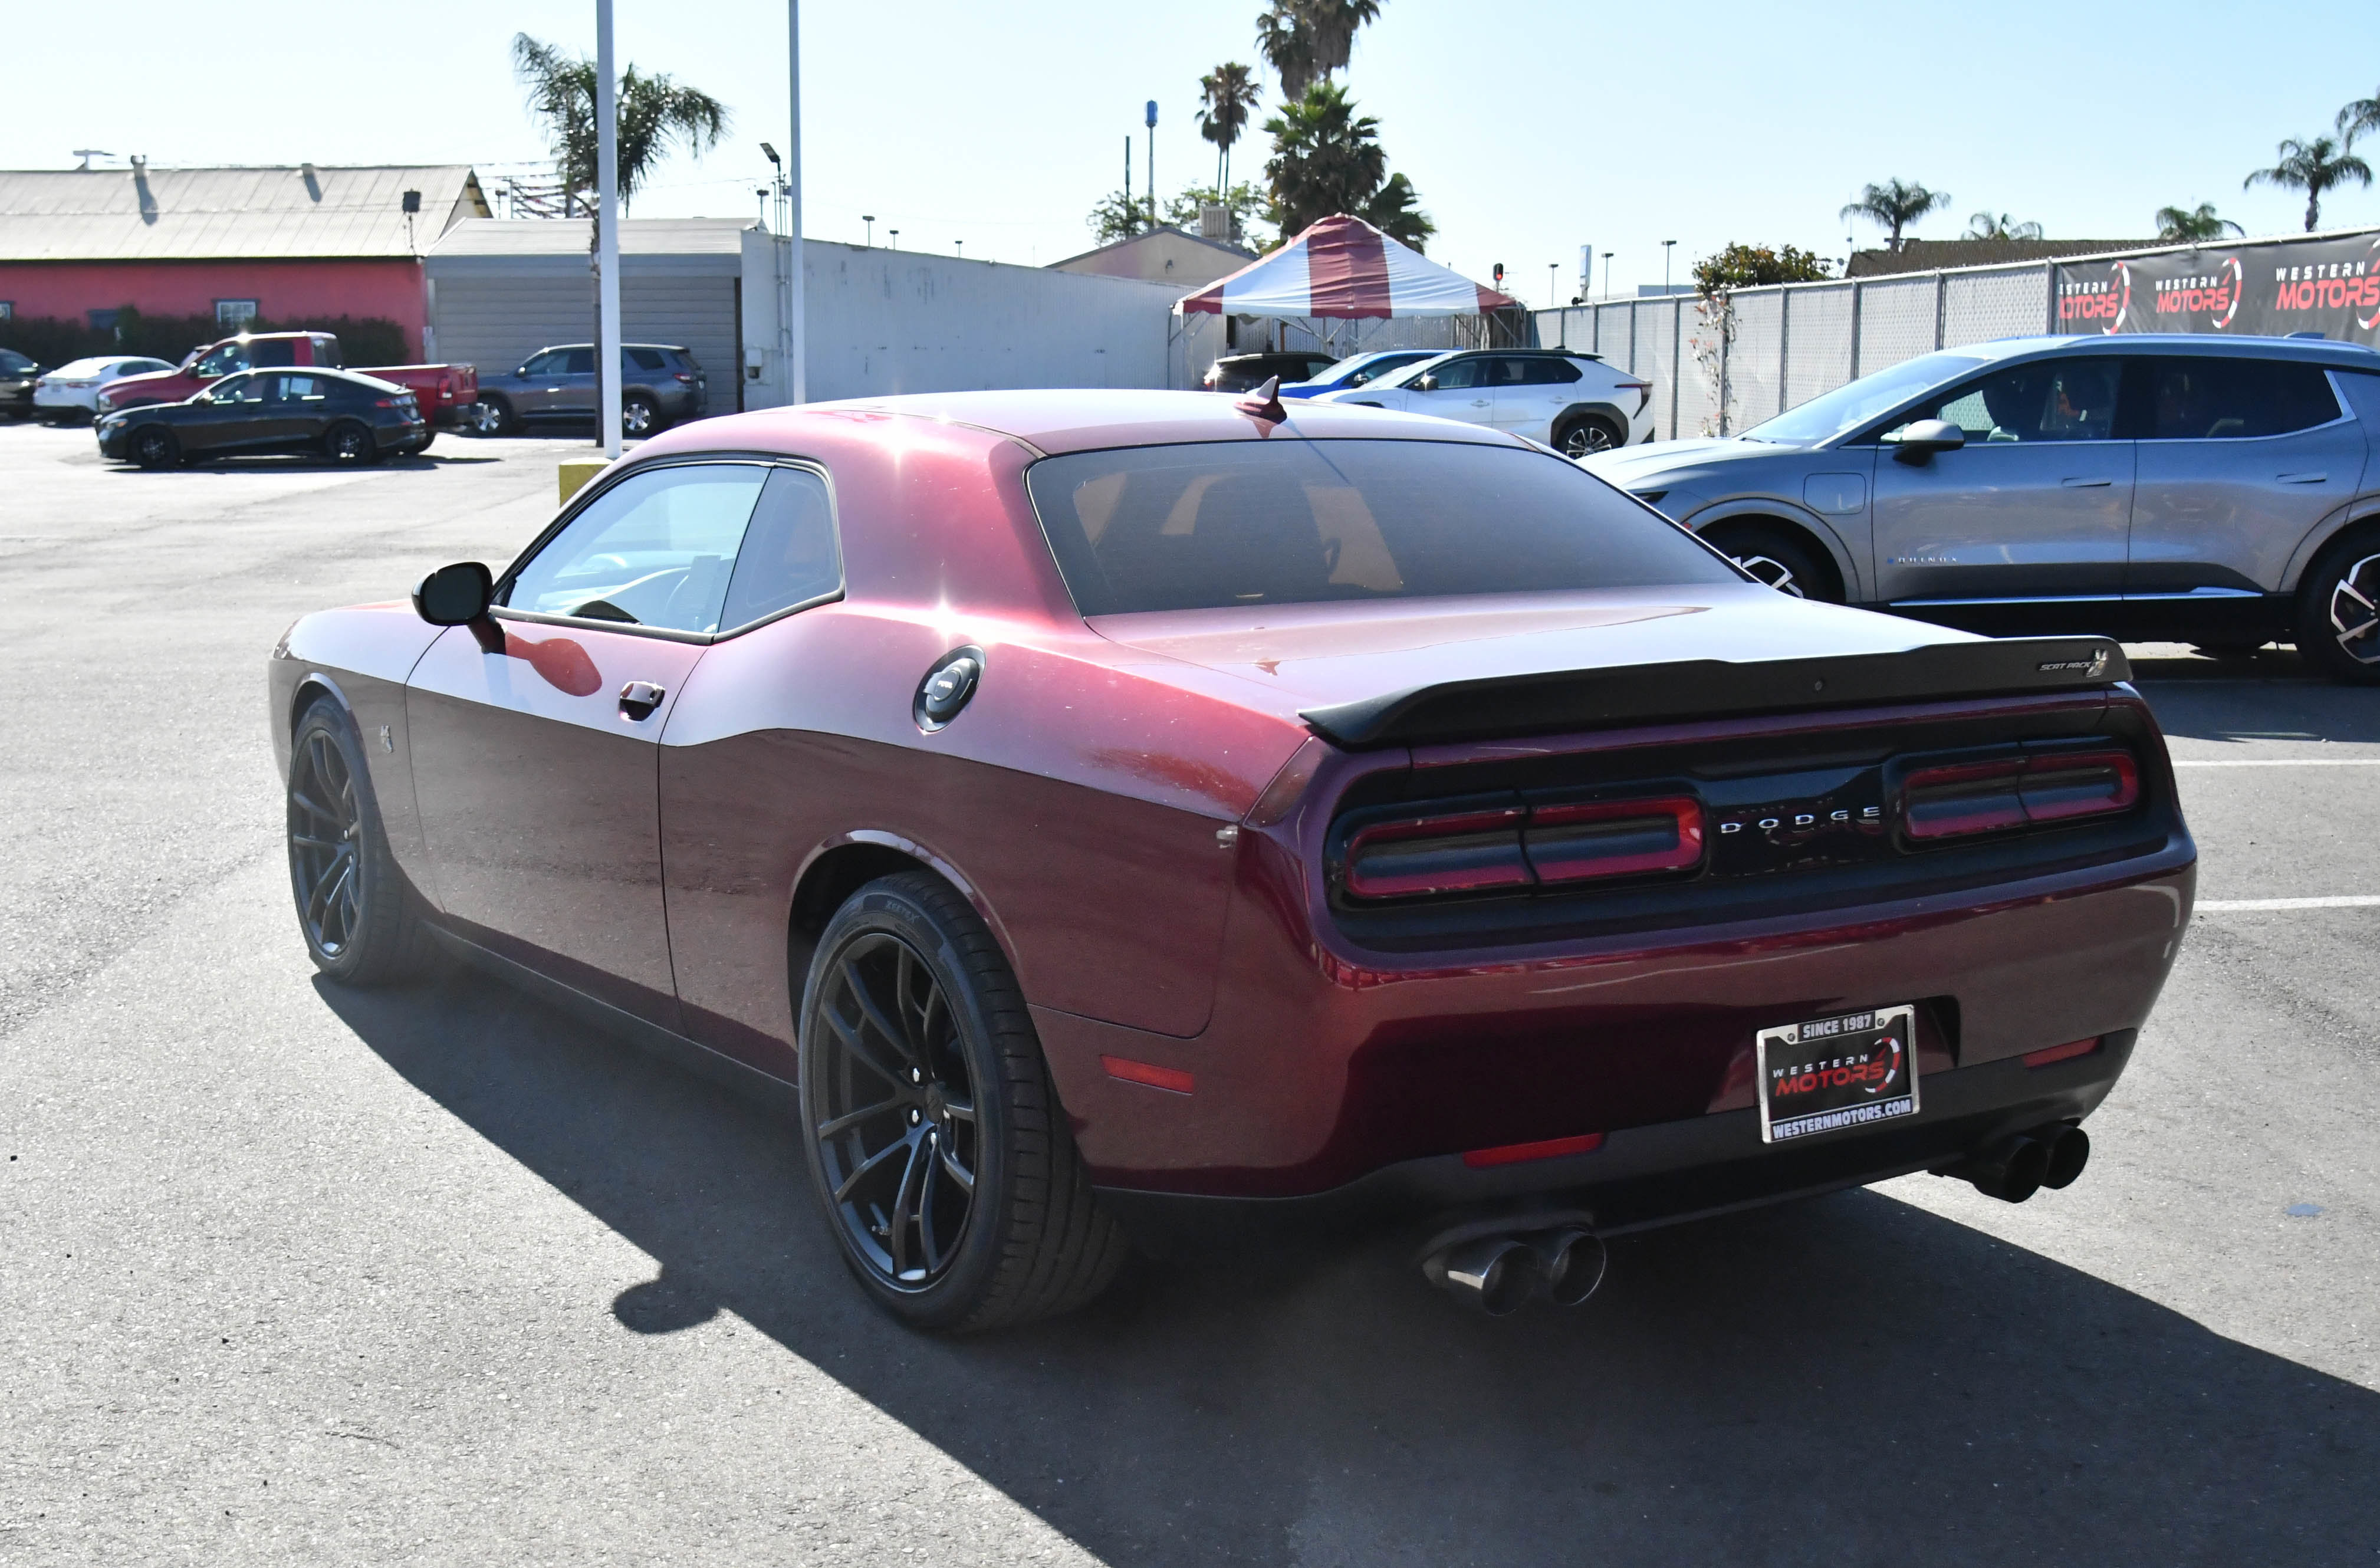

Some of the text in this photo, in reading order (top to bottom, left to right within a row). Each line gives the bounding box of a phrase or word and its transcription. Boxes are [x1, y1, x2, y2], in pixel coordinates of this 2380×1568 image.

[2276, 261, 2365, 281] WESTERN
[2155, 276, 2217, 291] WESTERN
[2276, 276, 2380, 310] MOTORS
[2156, 288, 2229, 313] MOTORS
[2039, 661, 2092, 671] SCAT PACK
[1721, 806, 1880, 834] DODGE
[1803, 1014, 1871, 1038] SINCE 1987
[1773, 1054, 1869, 1078] WESTERN
[1775, 1061, 1885, 1097] MOTORS
[1773, 1099, 1911, 1139] WESTERNMOTORS.COM
